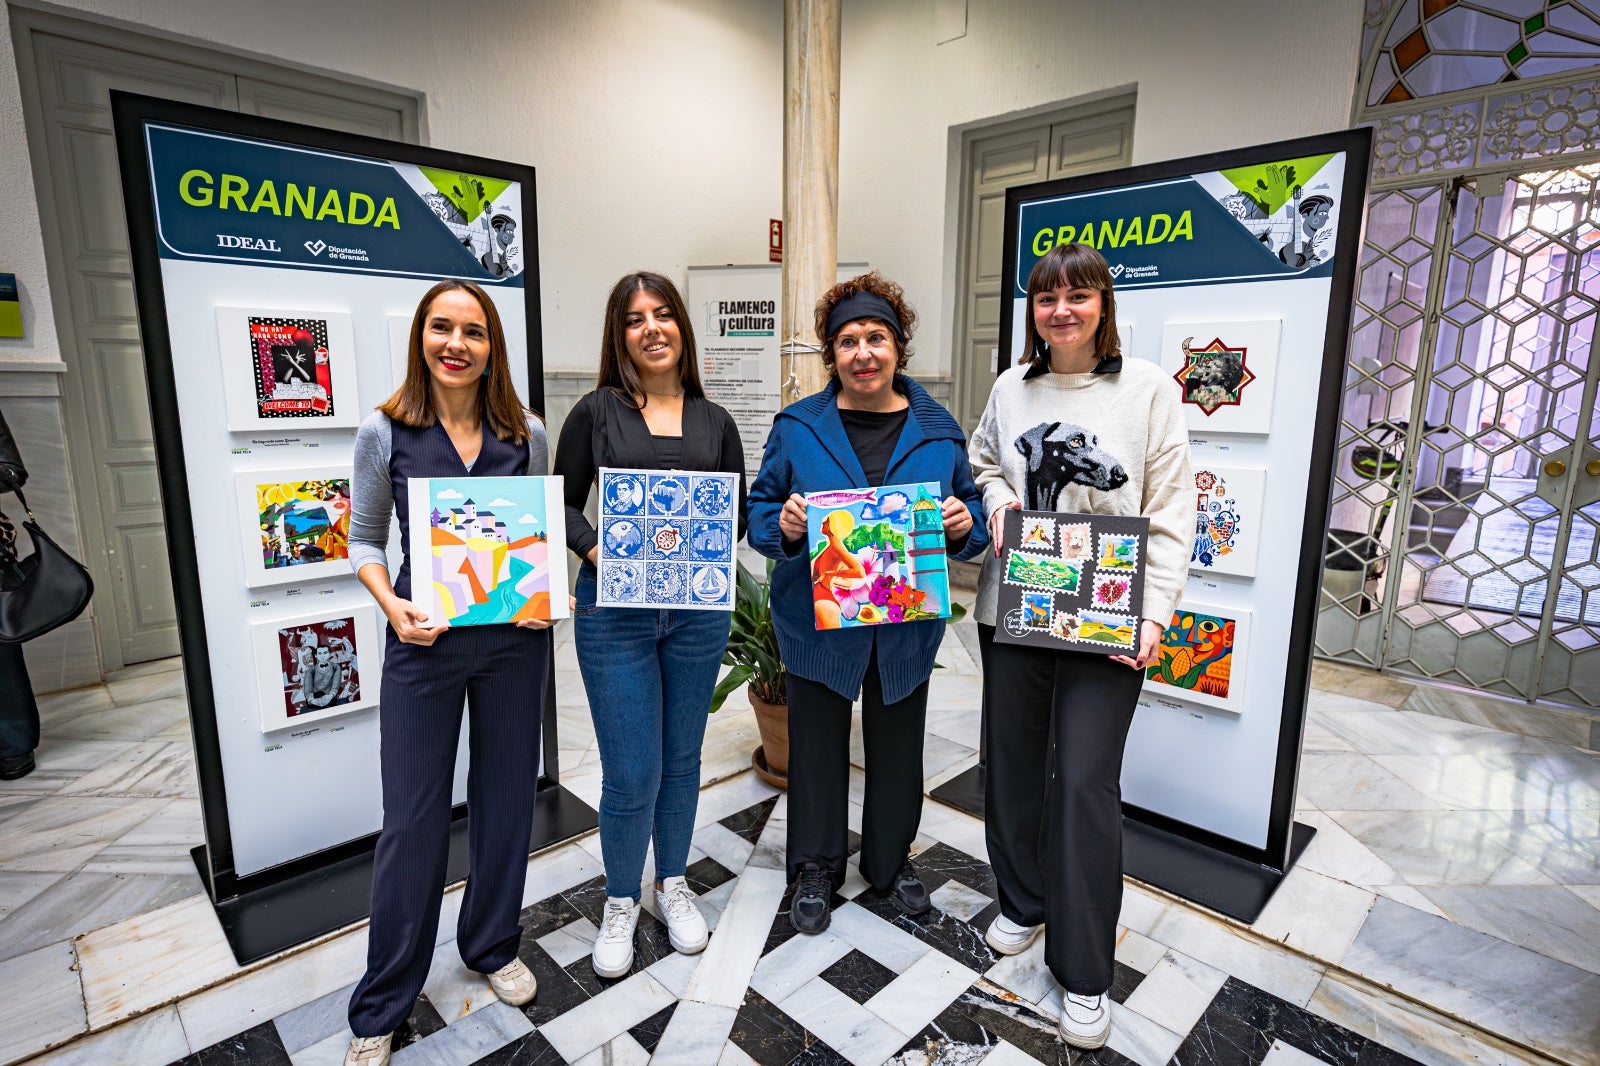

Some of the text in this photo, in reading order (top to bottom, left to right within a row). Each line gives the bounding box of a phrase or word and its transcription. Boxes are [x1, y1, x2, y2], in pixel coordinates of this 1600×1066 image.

[179, 169, 400, 230] GRANADA
[1032, 210, 1193, 257] GRANADA
[216, 234, 281, 252] IDEAL
[328, 245, 367, 255] Diputación
[339, 254, 370, 262] Granada
[1125, 265, 1158, 274] Diputación
[718, 300, 775, 315] FLAMENCO
[718, 315, 775, 337] y cultura
[264, 401, 300, 409] WELCOME
